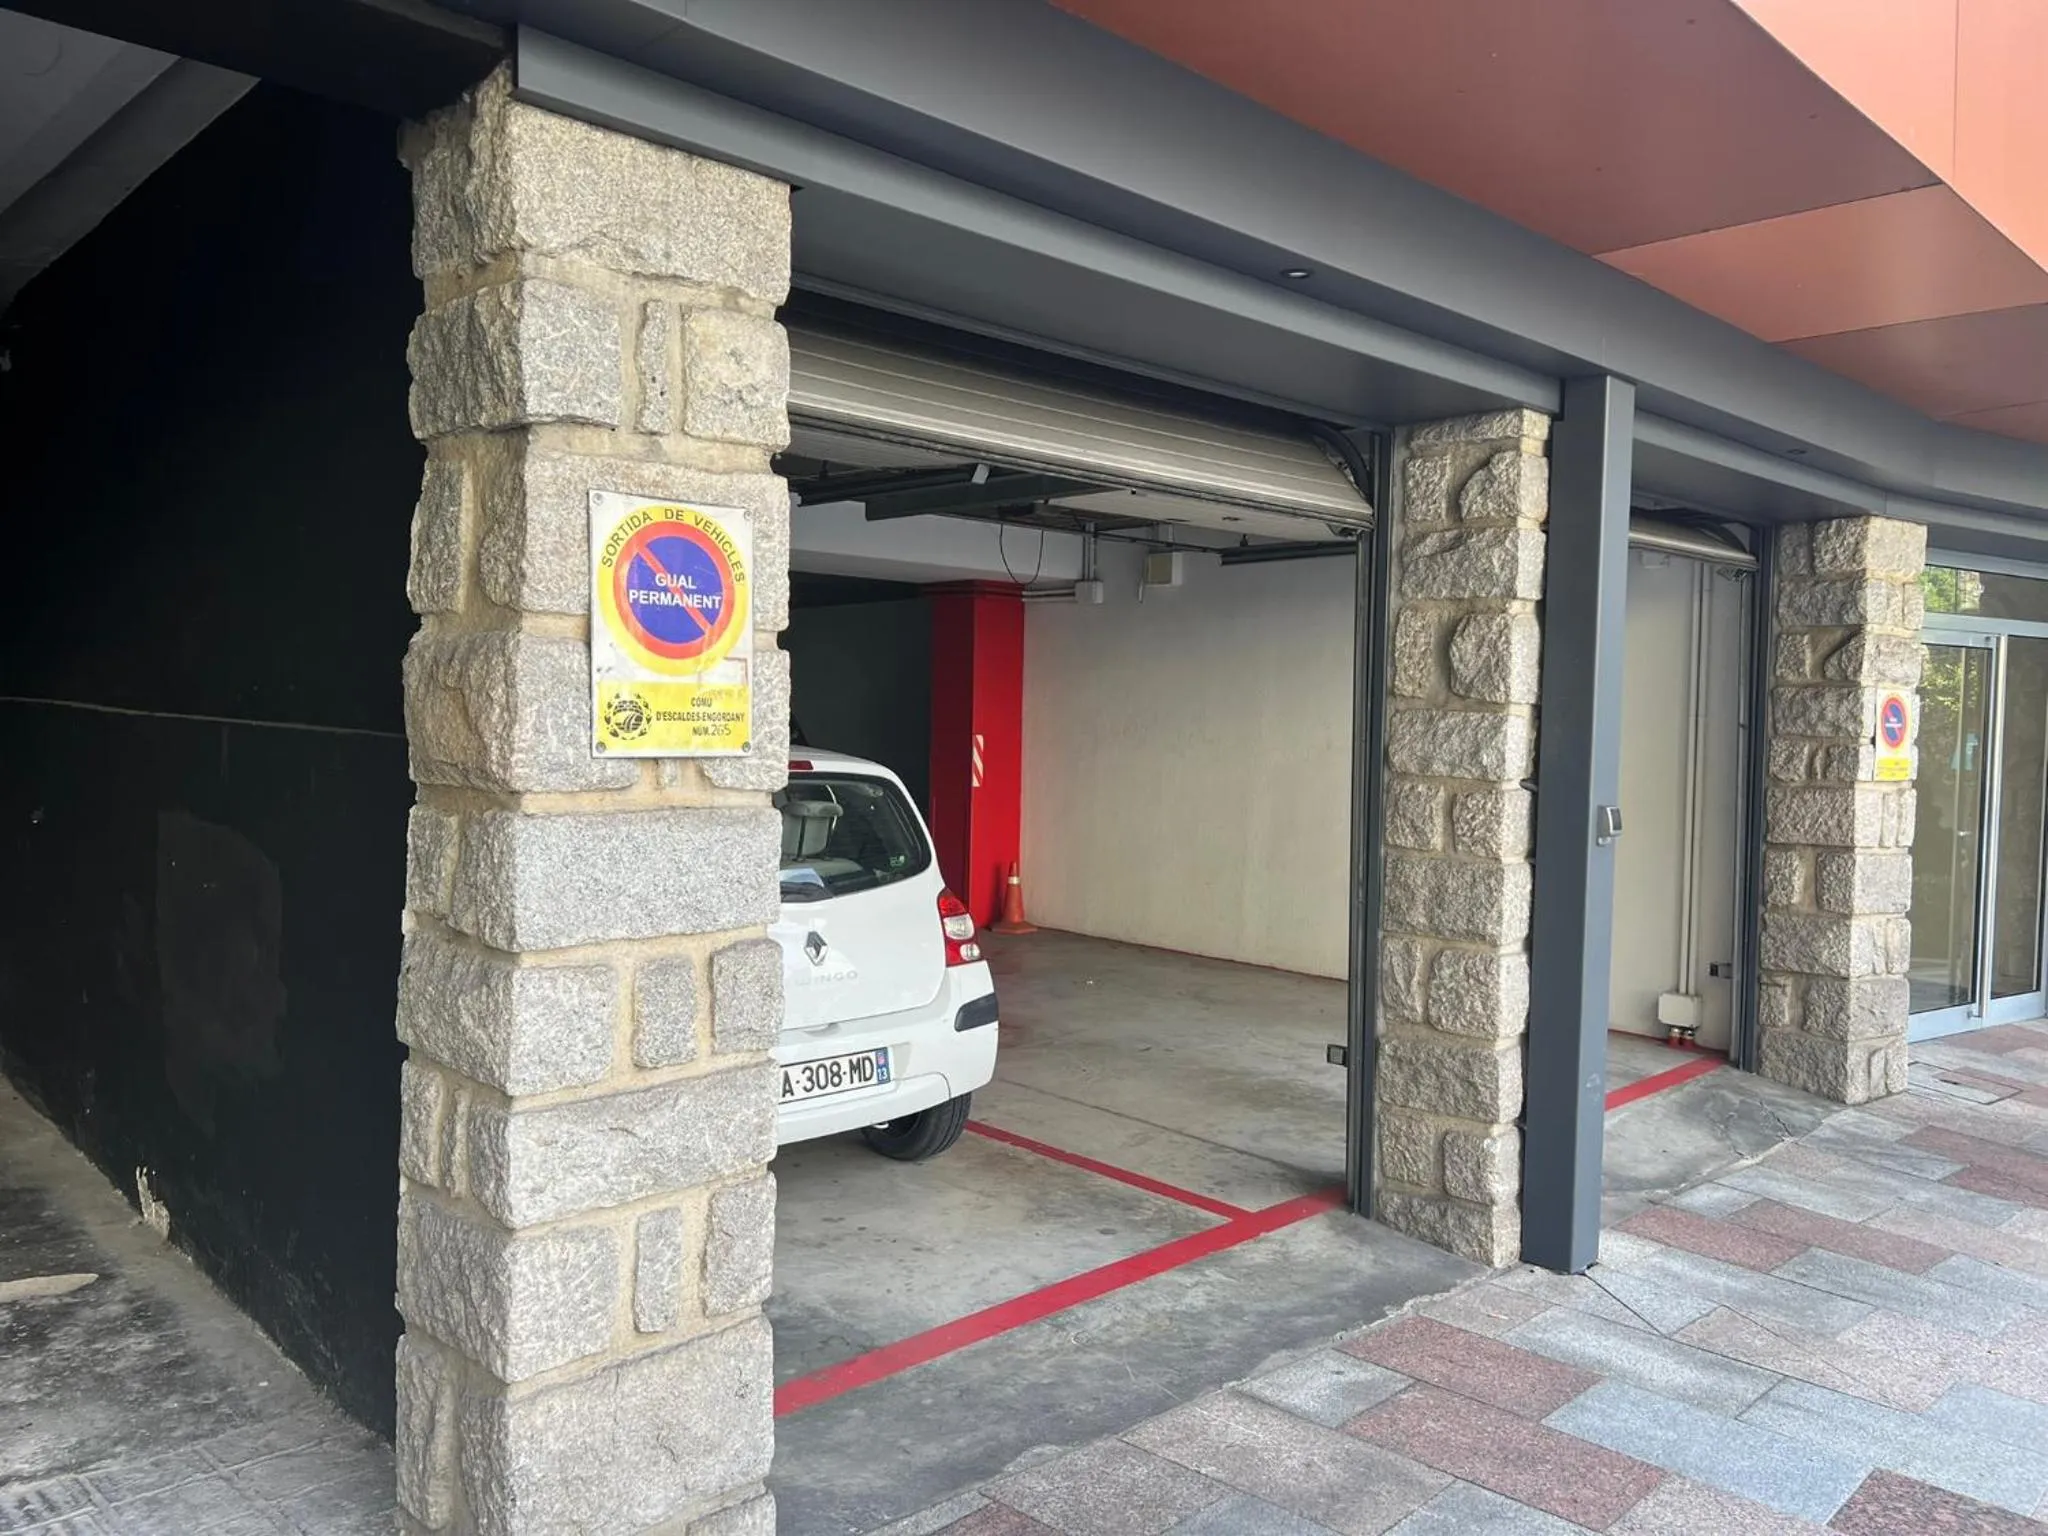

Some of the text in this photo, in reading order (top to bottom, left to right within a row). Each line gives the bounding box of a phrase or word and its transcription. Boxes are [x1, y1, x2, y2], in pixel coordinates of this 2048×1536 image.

[602, 508, 745, 583] SORTIDA DE VEHICLES
[655, 573, 697, 589] GUAL
[629, 589, 722, 609] PERMANENT
[781, 1055, 875, 1098] A-308-MD
[877, 1067, 888, 1081] 13
